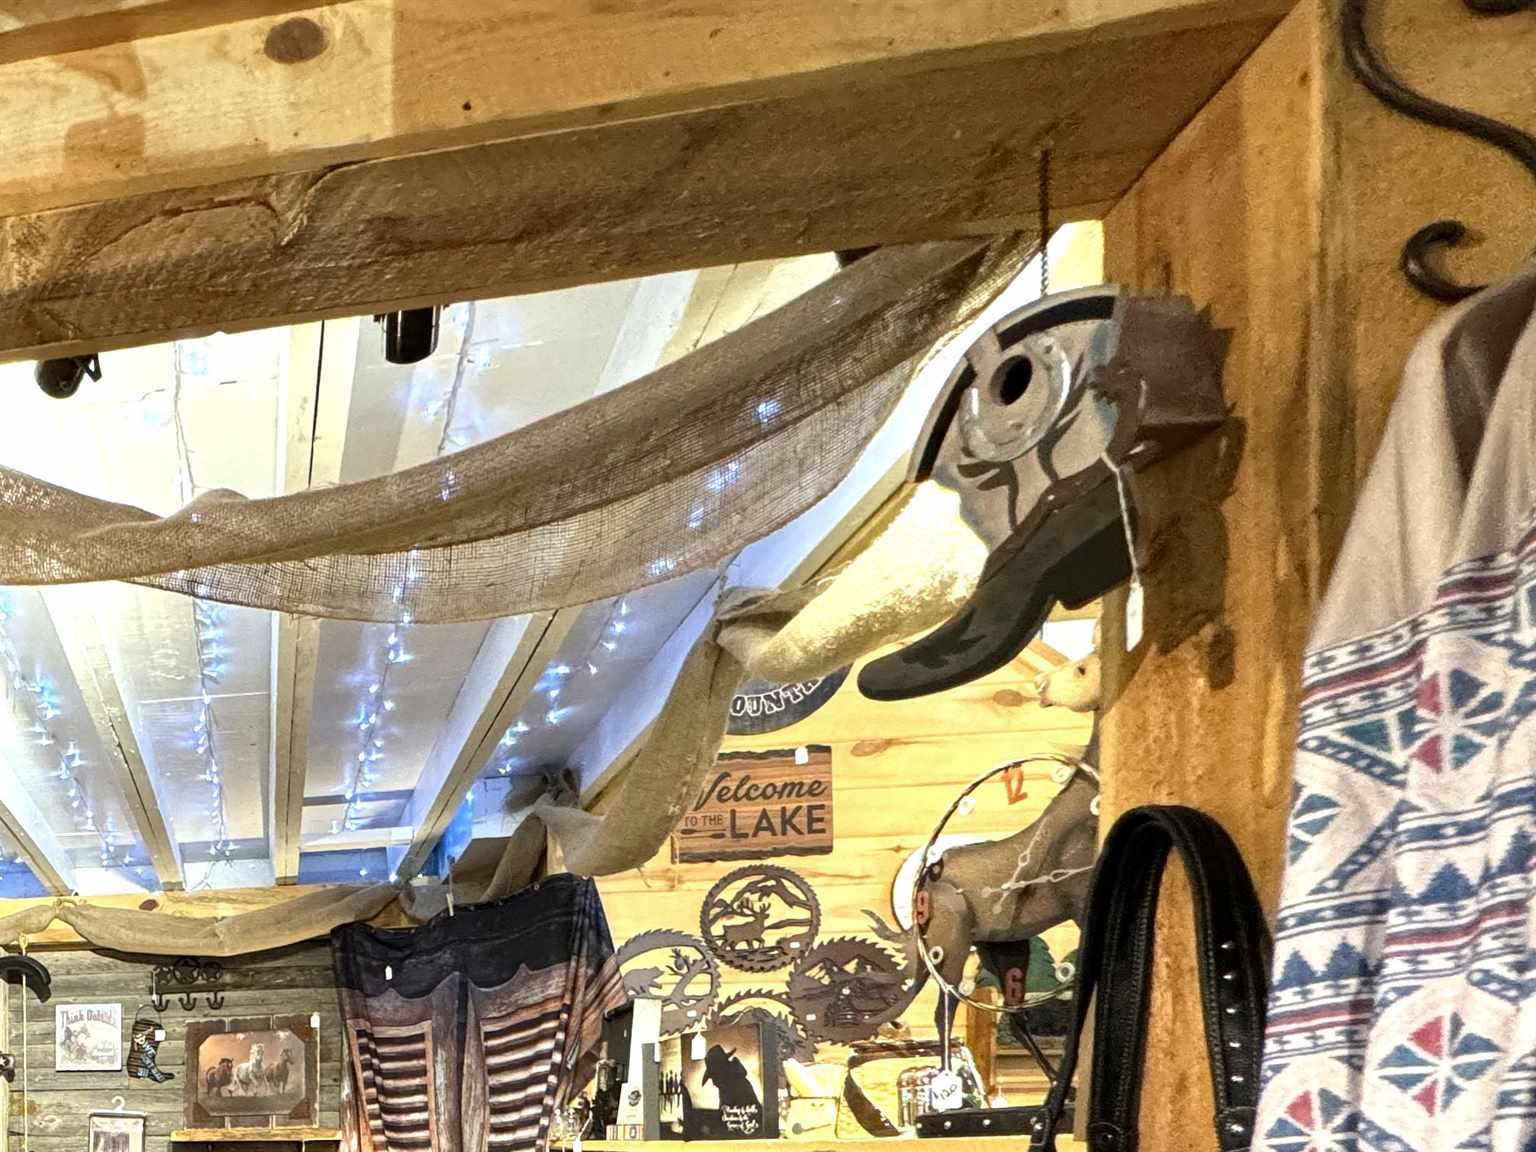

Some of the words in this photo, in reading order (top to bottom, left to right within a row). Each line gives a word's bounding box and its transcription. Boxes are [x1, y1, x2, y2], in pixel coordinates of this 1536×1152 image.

[730, 676, 825, 716] OUNT
[701, 814, 724, 826] THE
[730, 804, 826, 839] LAKE
